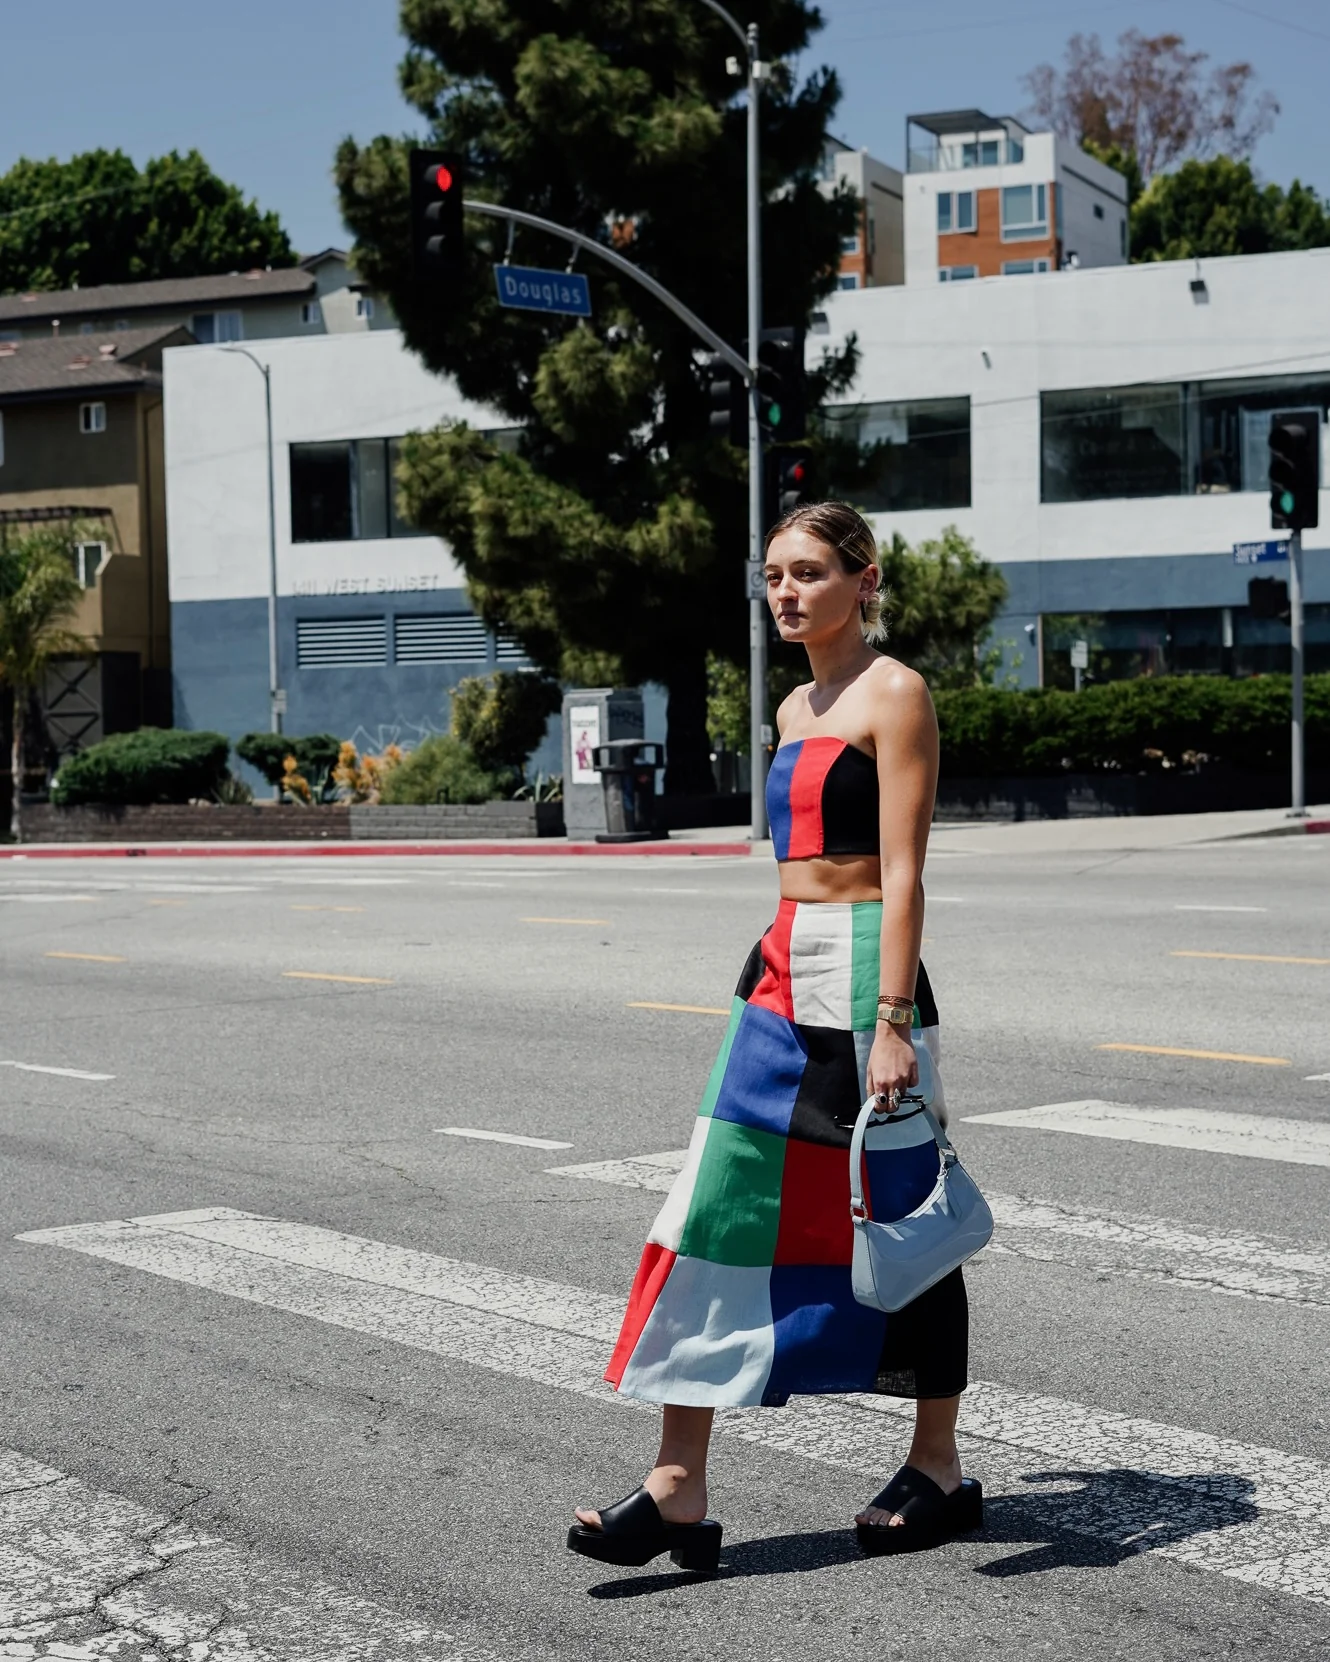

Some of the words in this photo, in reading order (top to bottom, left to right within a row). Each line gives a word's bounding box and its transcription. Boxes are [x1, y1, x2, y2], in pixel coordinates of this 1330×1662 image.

[504, 276, 582, 307] Douglas
[322, 577, 369, 596] WEST
[376, 574, 439, 594] SUNSET
